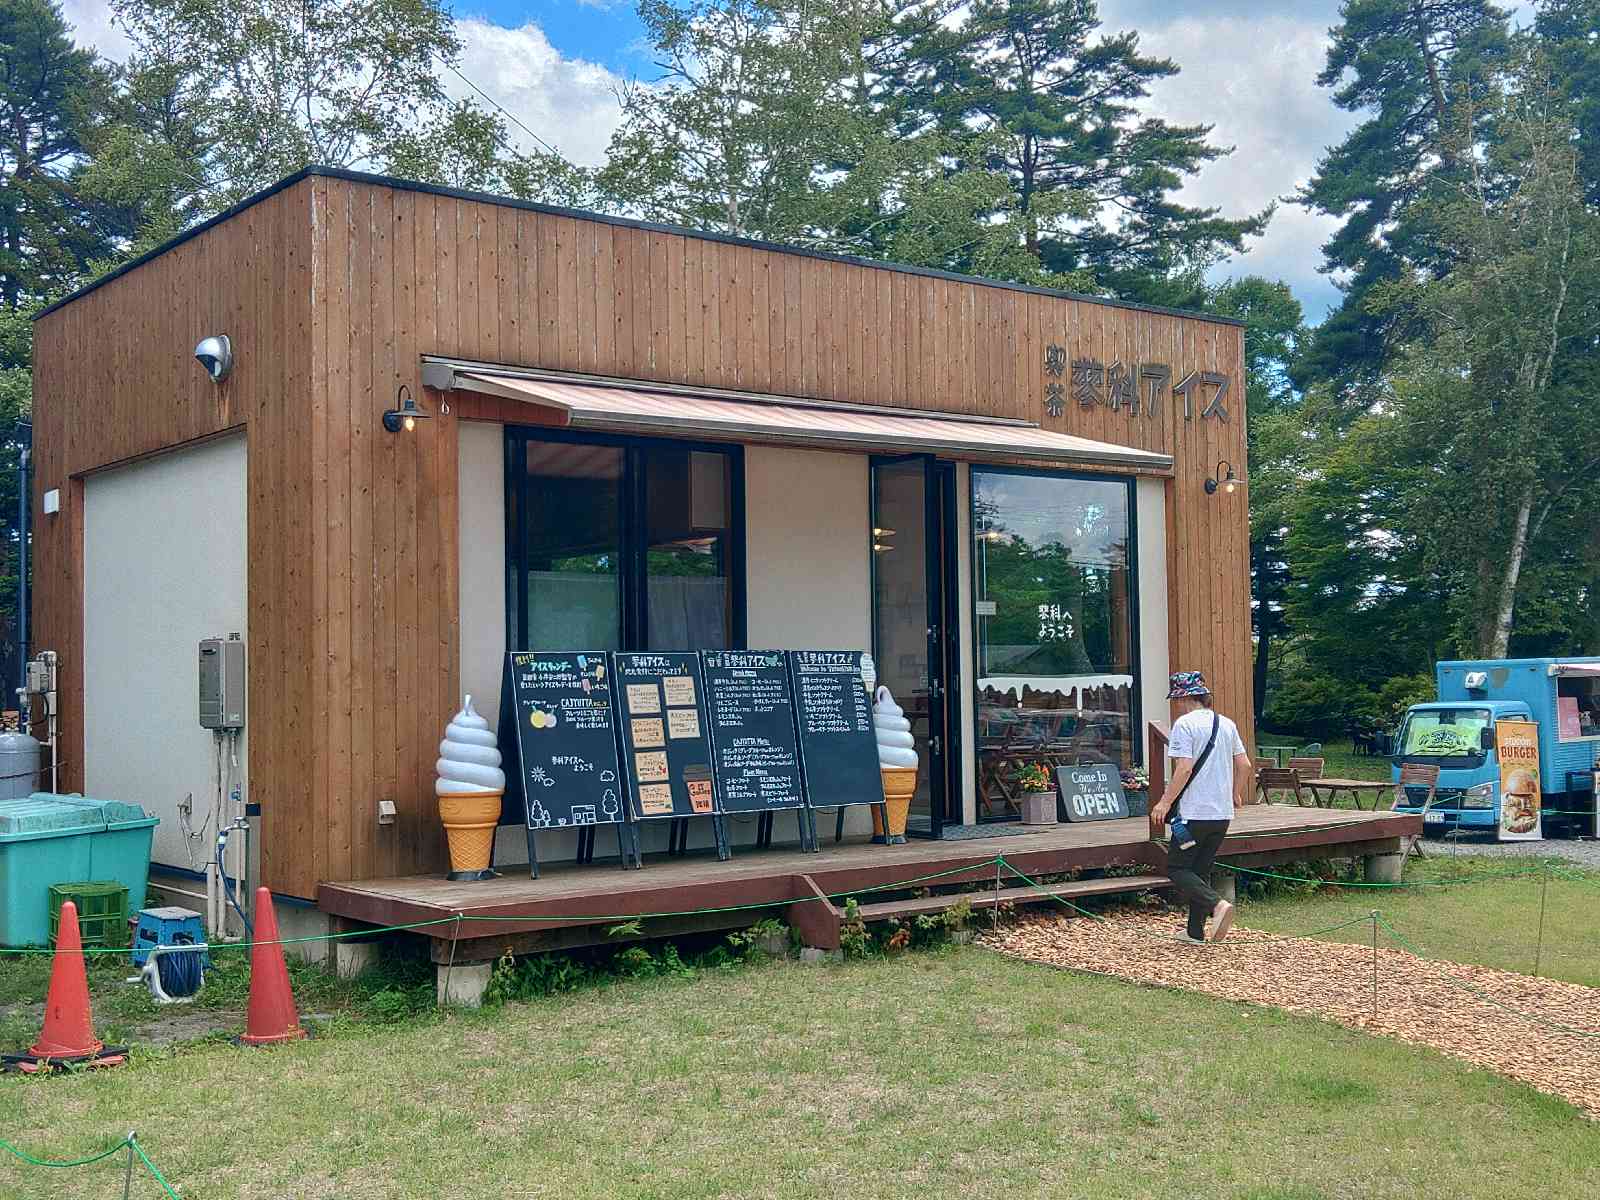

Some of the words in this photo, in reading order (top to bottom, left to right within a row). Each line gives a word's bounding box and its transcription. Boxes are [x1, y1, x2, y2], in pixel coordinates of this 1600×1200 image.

[1071, 356, 1232, 425] 蓼科アイス
[1038, 623, 1074, 639] ようこそ
[1500, 746, 1537, 760] BURGER
[1071, 770, 1097, 783] Come
[1097, 770, 1107, 782] In
[1072, 792, 1120, 817] OPEN
